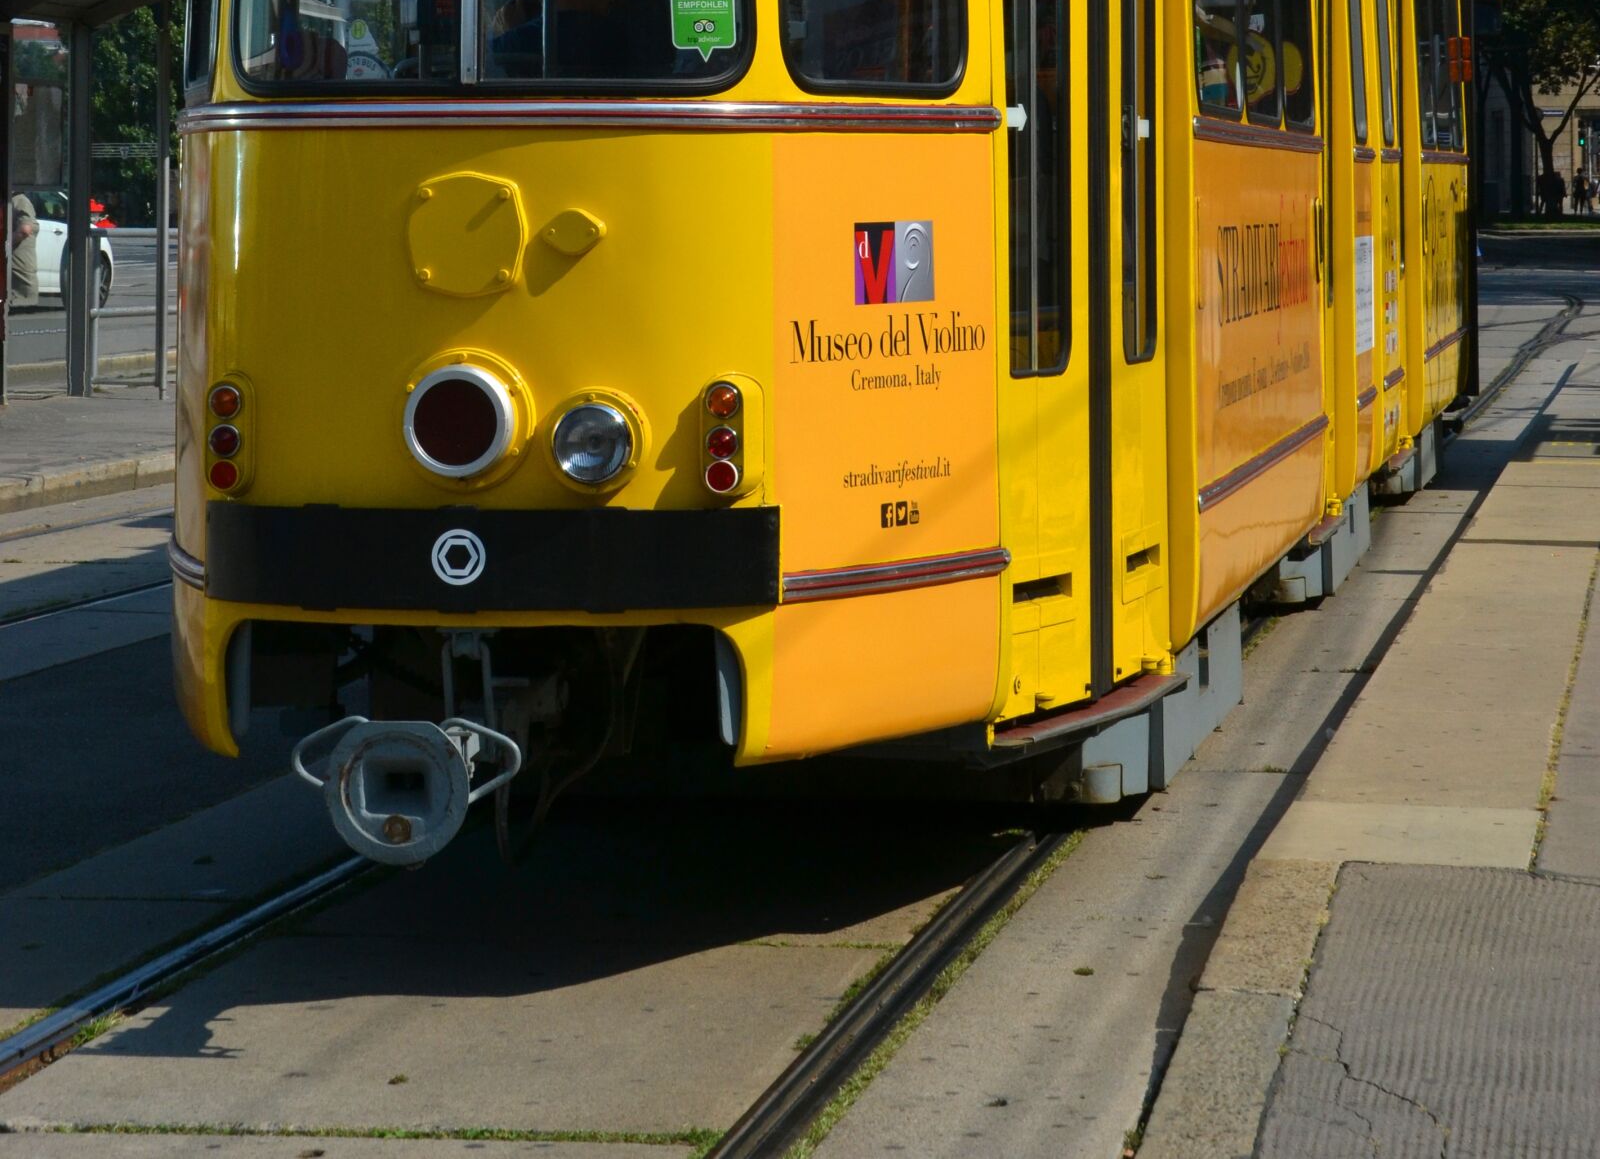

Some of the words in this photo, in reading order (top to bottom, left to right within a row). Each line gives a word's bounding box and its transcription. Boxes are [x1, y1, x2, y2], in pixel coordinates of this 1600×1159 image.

[677, 0, 728, 9] EMPFOHLEN
[790, 319, 872, 364] Museo
[880, 313, 912, 358] del
[915, 310, 985, 356] Violino
[851, 368, 912, 392] Cremona,
[915, 363, 941, 390] Italy
[843, 456, 951, 488] stradivarifestival.it
